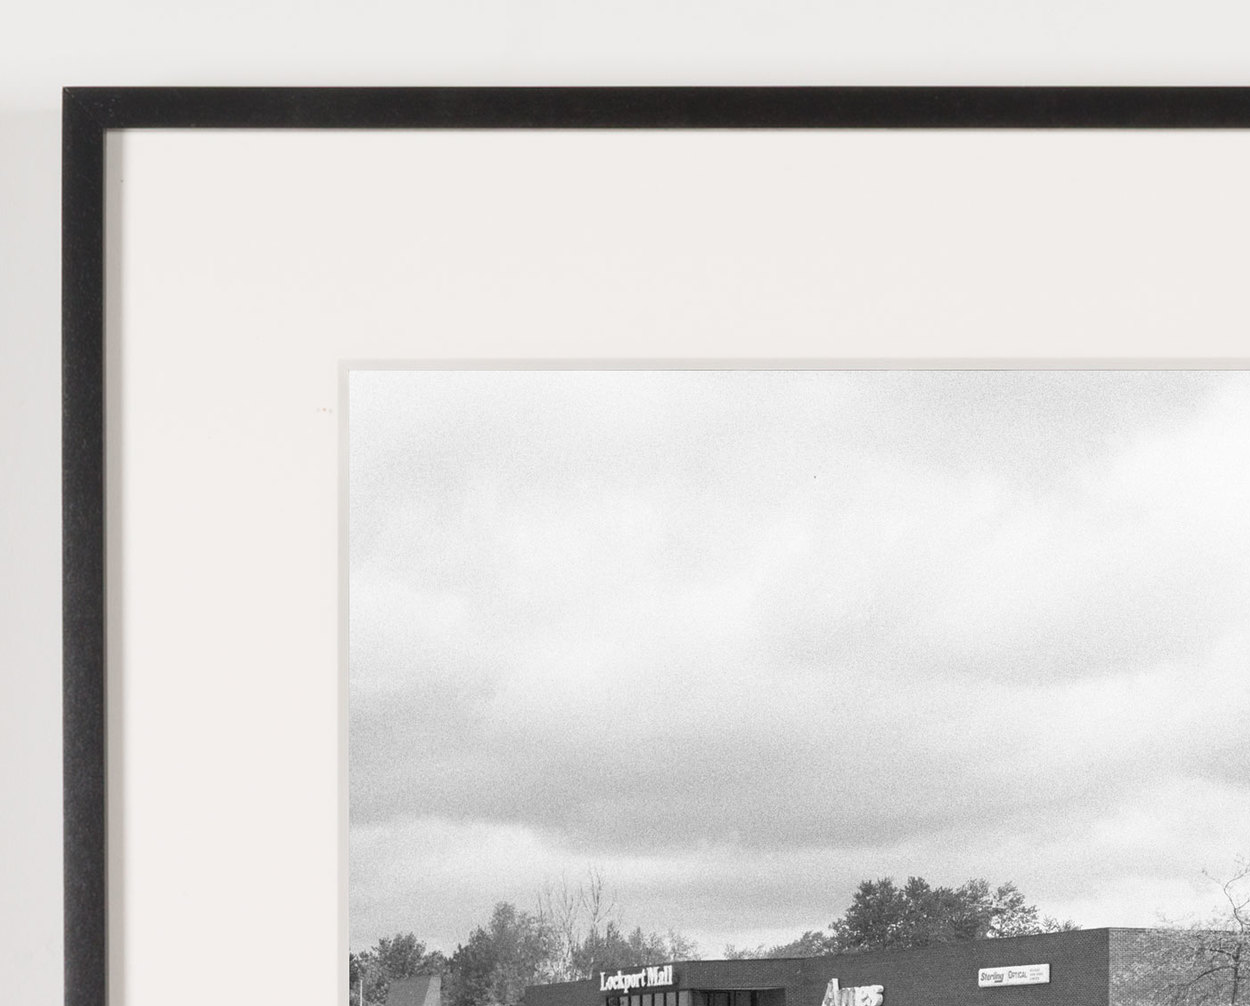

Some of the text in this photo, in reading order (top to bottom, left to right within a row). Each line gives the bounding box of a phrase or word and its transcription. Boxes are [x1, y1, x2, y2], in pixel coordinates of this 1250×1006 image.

[600, 965, 673, 993] Lockport Mall
[981, 972, 1004, 983] Sterling
